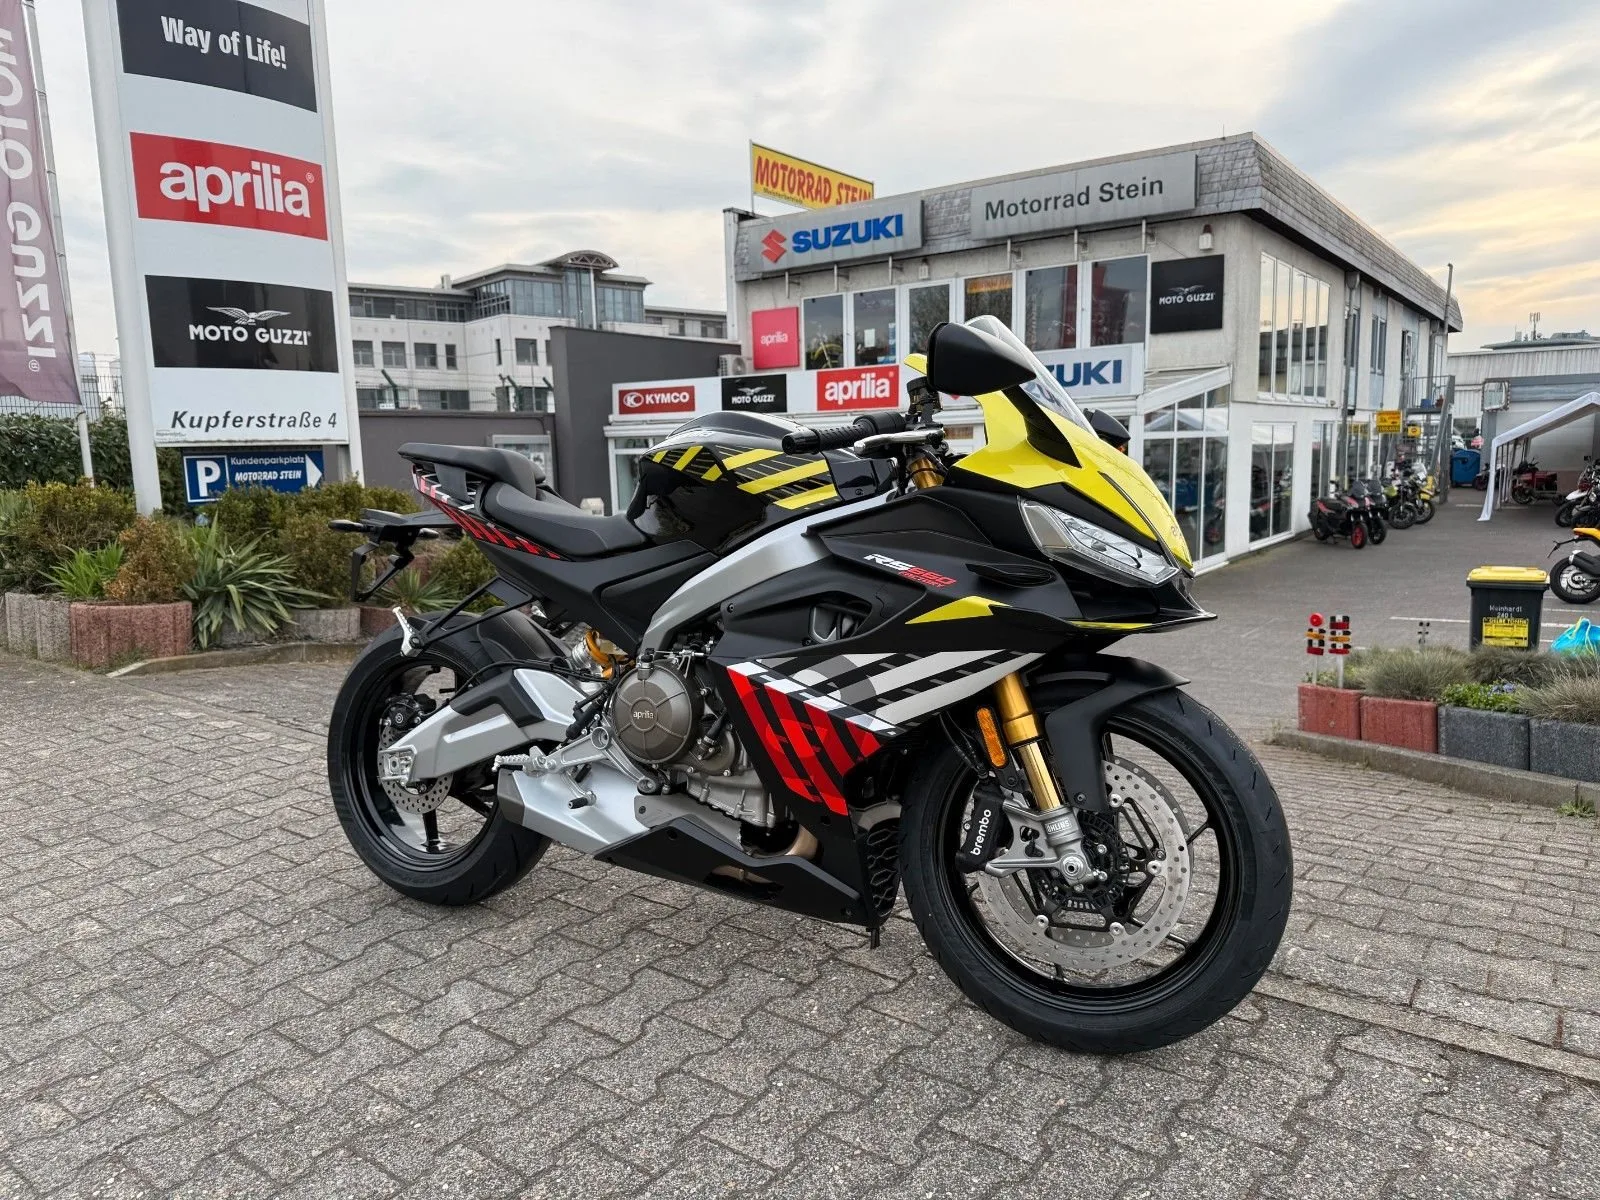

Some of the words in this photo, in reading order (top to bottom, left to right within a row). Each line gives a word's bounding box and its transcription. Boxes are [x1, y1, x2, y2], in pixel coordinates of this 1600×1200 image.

[161, 16, 211, 54] Way
[219, 30, 240, 56] of
[246, 35, 287, 69] Life!
[160, 160, 311, 218] aprilia
[755, 156, 832, 204] MOTORRAD
[985, 186, 1090, 221] Motorrad
[1099, 177, 1163, 203] Stein
[792, 214, 903, 253] SUZUKI
[1159, 294, 1184, 305] MOTO
[1186, 293, 1214, 303] GUZZI
[189, 324, 248, 342] MOTO
[255, 328, 308, 345] GUZZI
[760, 332, 788, 345] aprilia
[645, 391, 689, 404] KYMCO
[731, 395, 751, 404] MOTO
[753, 394, 775, 404] GUZZI
[824, 373, 890, 404] aprilia
[171, 410, 322, 432] Kupferstraße
[328, 412, 337, 428] 4
[230, 456, 305, 466] Kundenparkplatz
[196, 460, 221, 497] P
[235, 470, 278, 481] MOTORRAD
[279, 470, 302, 480] STEIN
[632, 709, 654, 719] aprilia
[970, 809, 992, 856] brembo
